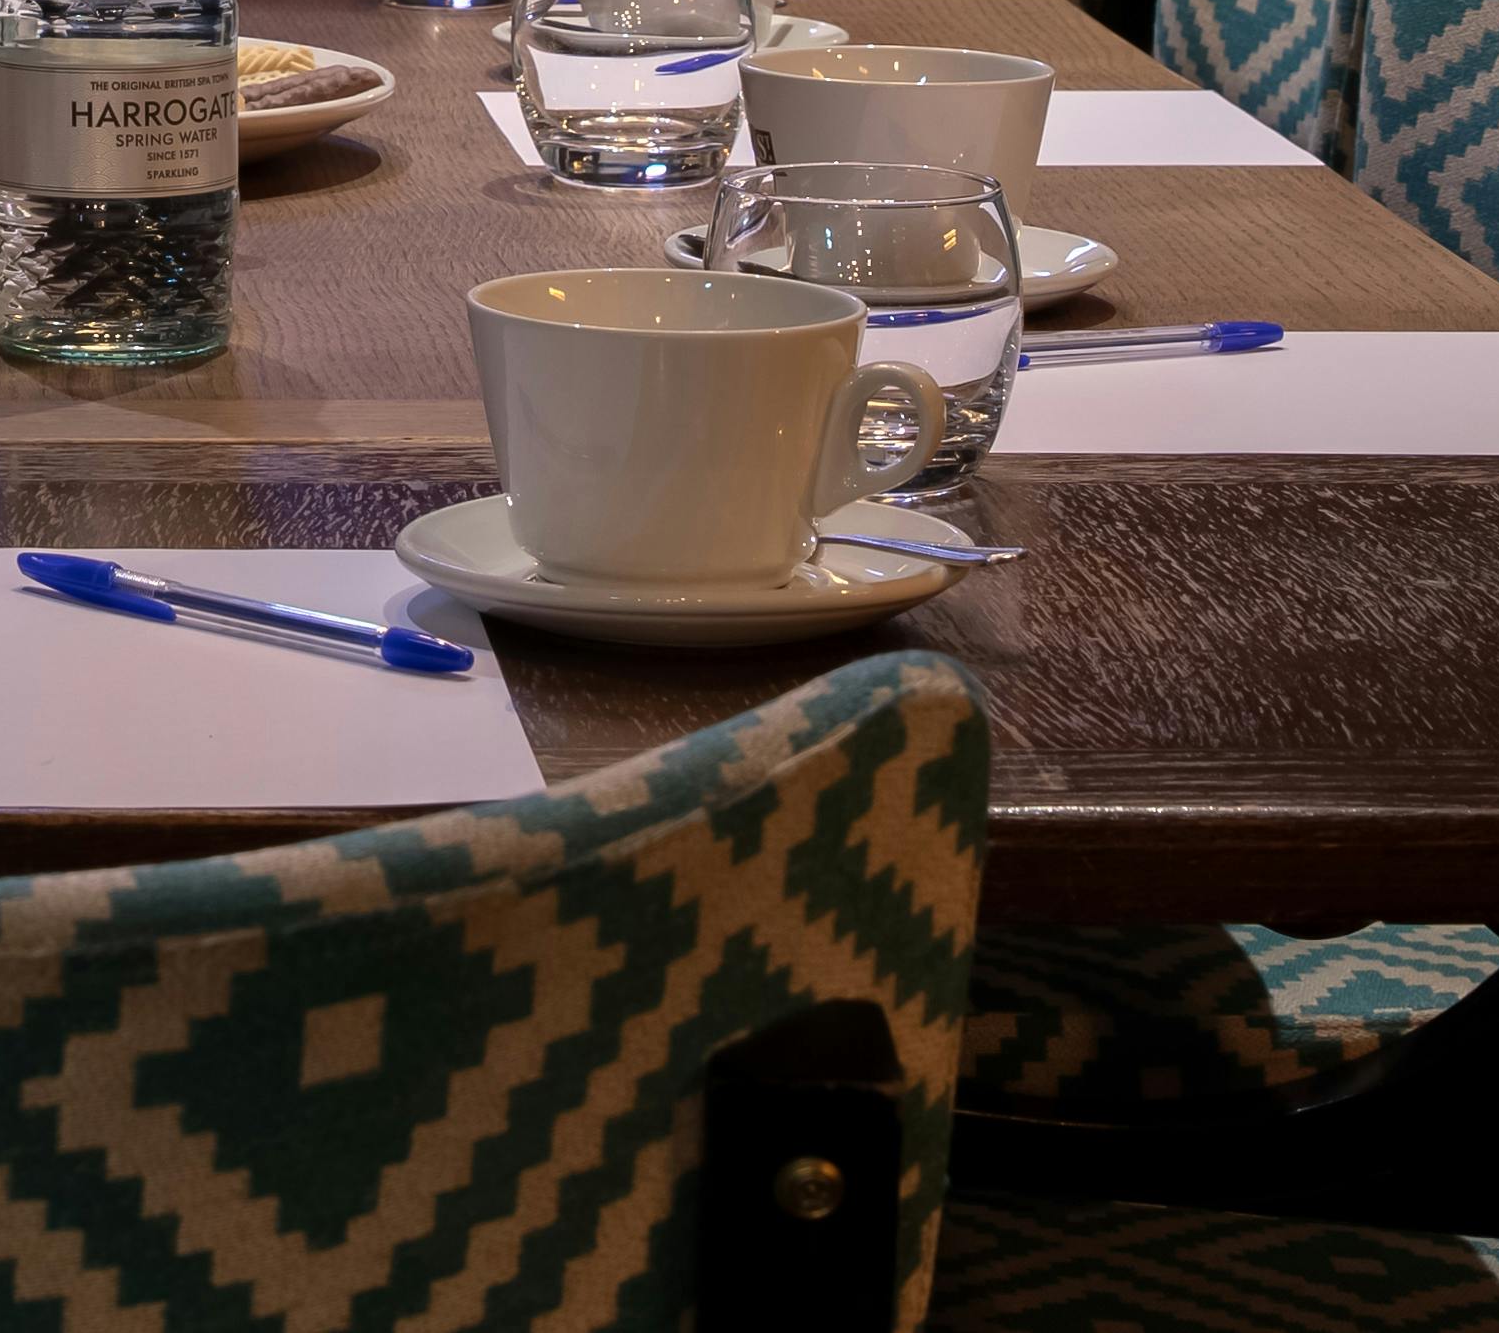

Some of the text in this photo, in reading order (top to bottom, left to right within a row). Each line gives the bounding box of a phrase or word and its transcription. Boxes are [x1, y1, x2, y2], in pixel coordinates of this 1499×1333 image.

[90, 72, 230, 91] THE ORIGINAL BRITISH SPA TOWN
[71, 90, 237, 128] HARROGATE
[116, 127, 218, 148] SPRING WATER
[147, 148, 200, 162] SINCE 1571
[146, 166, 200, 180] SPARKLING
